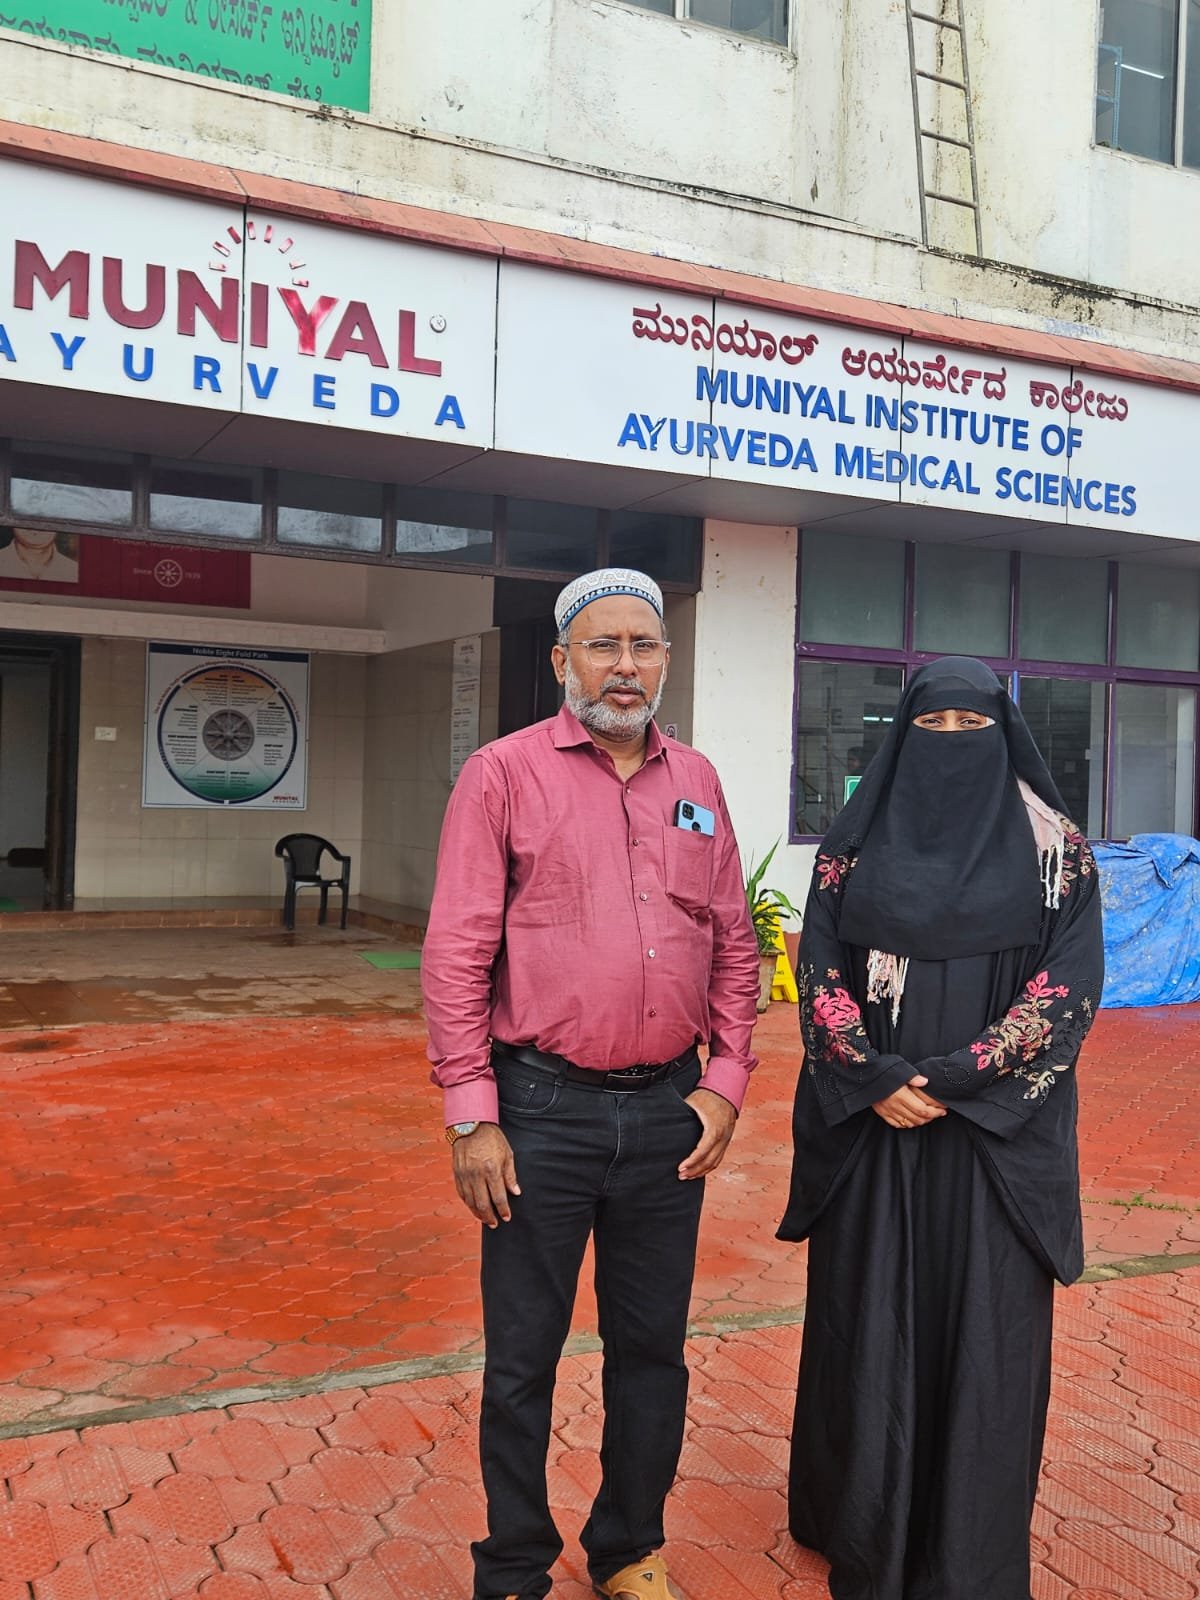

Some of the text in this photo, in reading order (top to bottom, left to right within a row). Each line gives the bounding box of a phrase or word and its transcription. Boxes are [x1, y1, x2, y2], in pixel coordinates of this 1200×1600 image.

[14, 239, 443, 377] MUNIYAL
[632, 303, 819, 365] ಮುನಿಯಾಲ್
[1029, 379, 1129, 422] ಕಾಲೇಜು
[696, 365, 1083, 458] MUNIYAL INSTITUTE OF
[617, 412, 1137, 517] AYURVEDA MEDICAL SCIENCES
[192, 647, 214, 655] Noble
[215, 649, 235, 658] Eight
[235, 650, 252, 658] Fold
